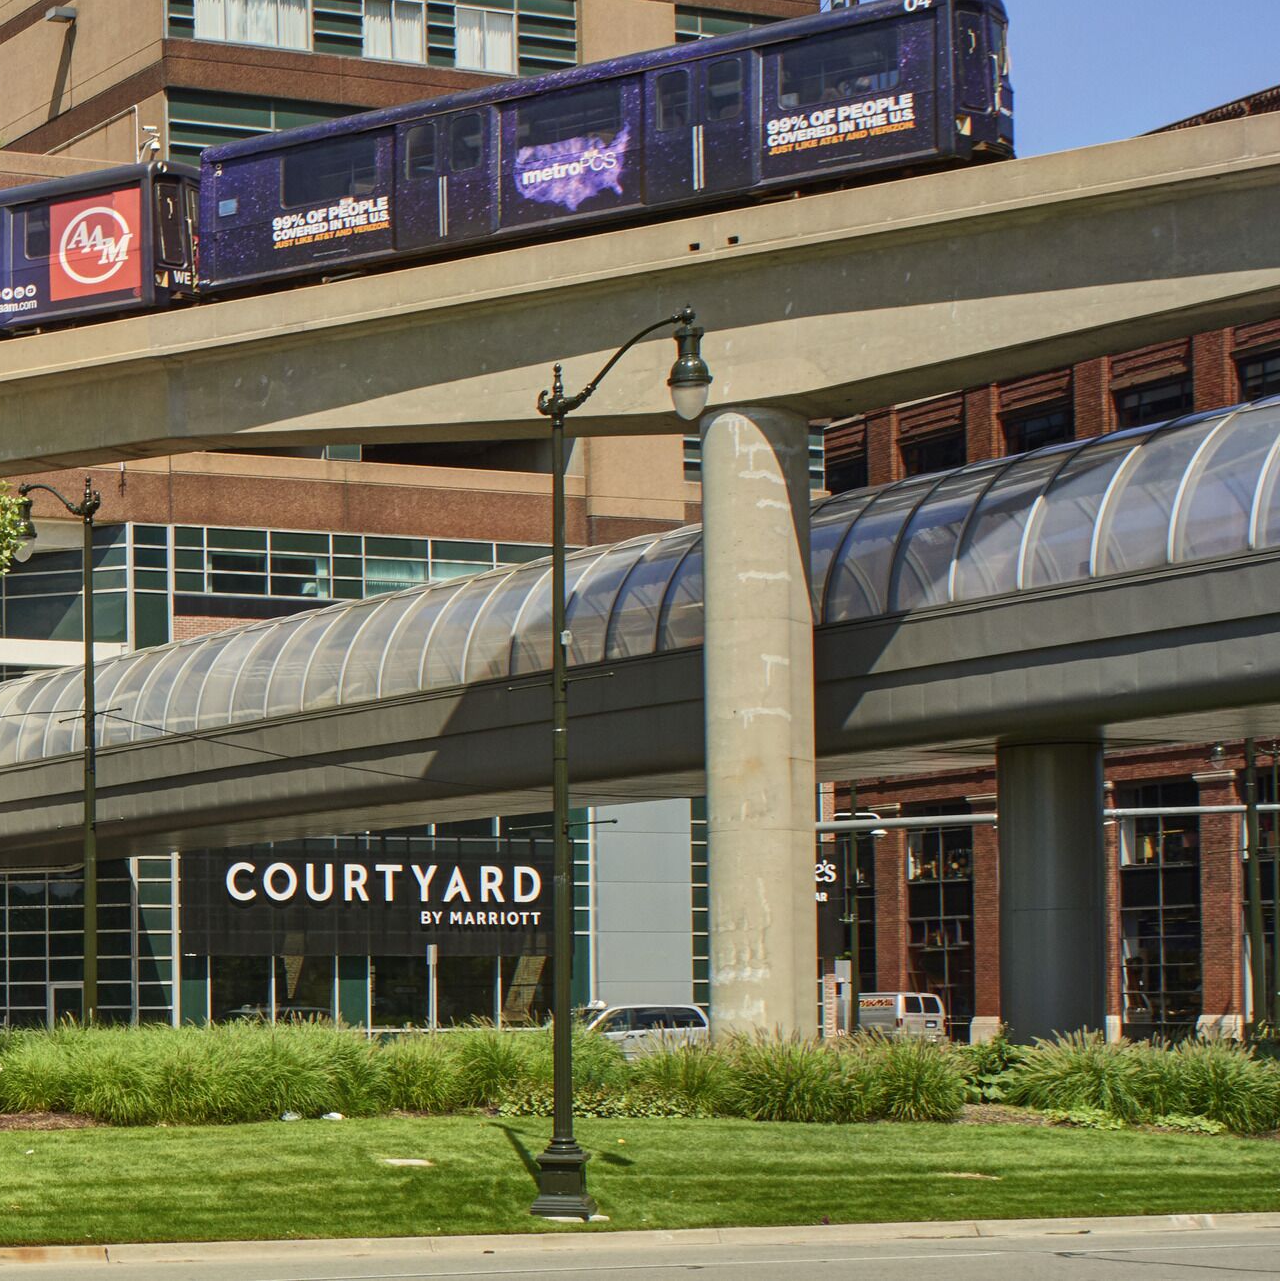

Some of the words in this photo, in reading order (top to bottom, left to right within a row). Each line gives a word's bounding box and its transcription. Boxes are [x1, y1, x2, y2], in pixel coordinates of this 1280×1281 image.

[767, 114, 809, 134] 99%
[809, 108, 836, 126] OF
[837, 93, 913, 121] PEOPLE
[767, 124, 838, 147] COVERED
[839, 121, 855, 134] IN
[855, 115, 888, 130] THE
[769, 144, 794, 156] JUST
[795, 139, 818, 150] LIKE
[819, 133, 845, 146] AT&T
[846, 130, 868, 141] AND
[522, 152, 616, 185] metroPCS
[272, 212, 306, 230] 99%
[306, 208, 328, 224] OF
[328, 196, 388, 220] PEOPLE
[273, 221, 328, 241] COVERED
[329, 218, 343, 230] IN
[343, 213, 368, 228] THE
[67, 220, 133, 265] AAM
[274, 240, 294, 250] JUST
[294, 235, 313, 245] LIKE
[314, 230, 335, 241] AT&T
[335, 227, 353, 238] AND
[173, 270, 191, 284] WE
[226, 862, 541, 903] COURTYARD
[421, 911, 443, 925] BY
[450, 912, 541, 925] MARRIOTT
